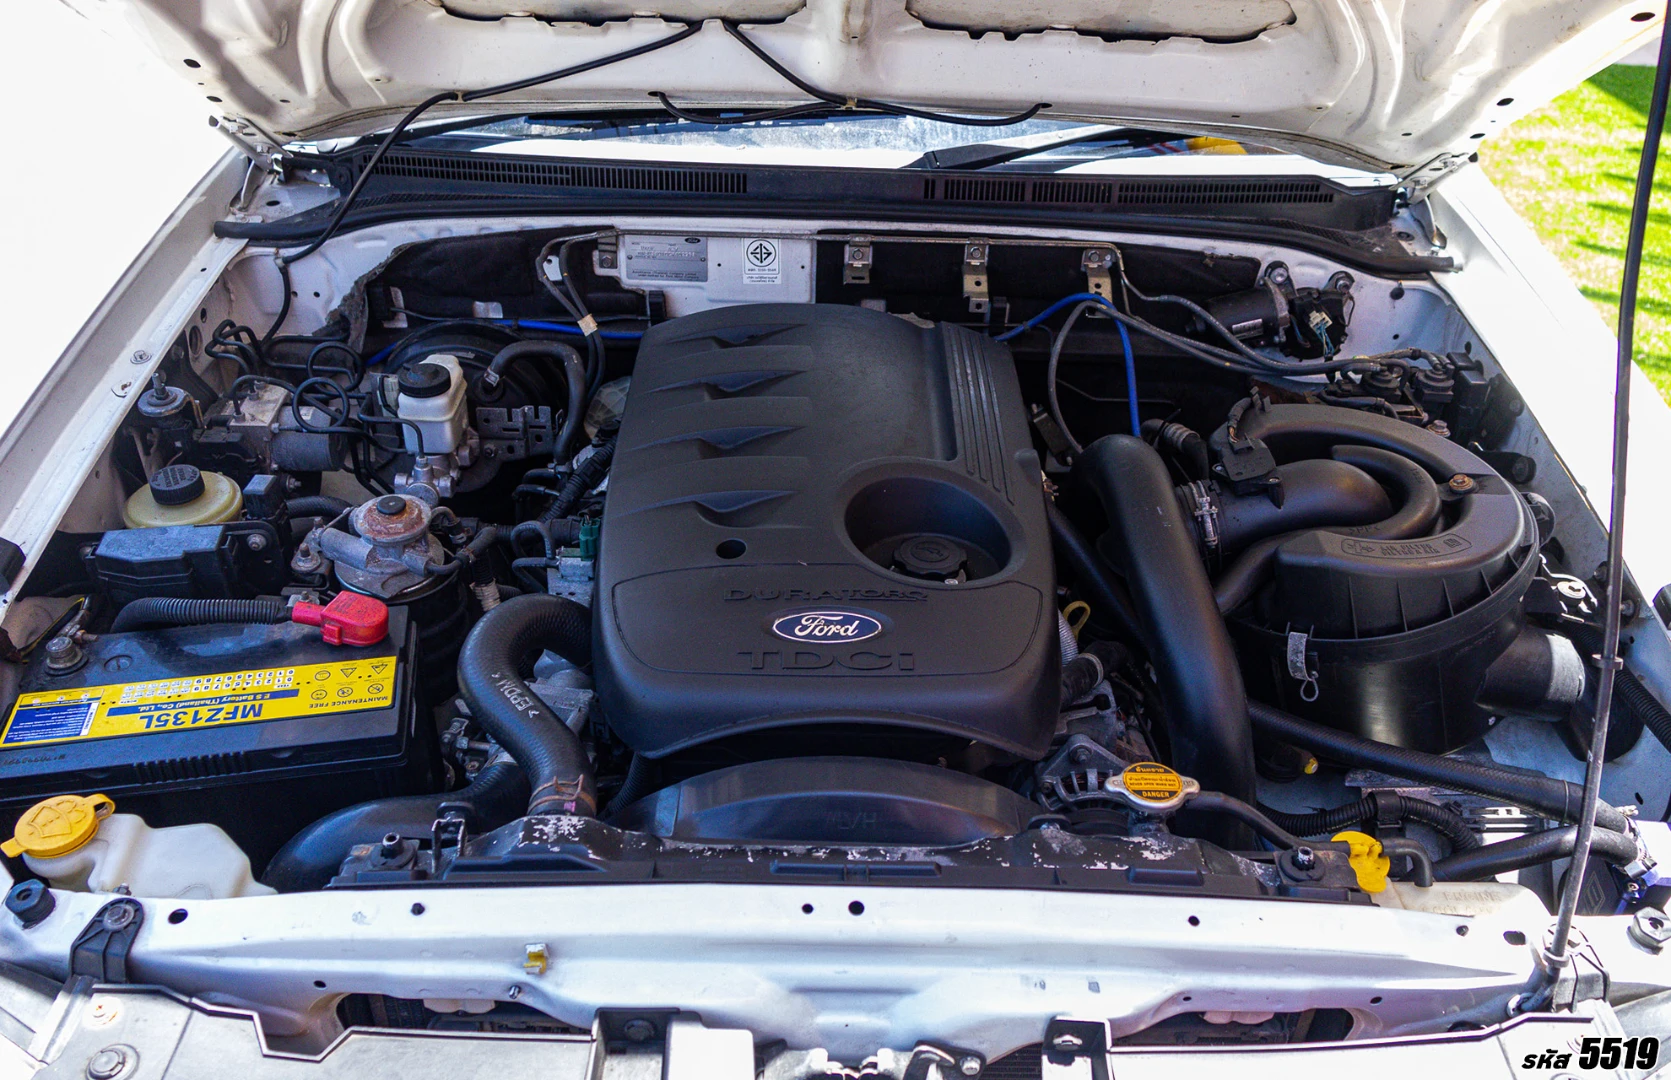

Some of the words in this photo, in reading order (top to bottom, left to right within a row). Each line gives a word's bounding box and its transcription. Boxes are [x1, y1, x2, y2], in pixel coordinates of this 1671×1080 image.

[723, 589, 929, 602] DURATORQ
[794, 613, 859, 637] Ford
[175, 697, 220, 708] (Thailand)
[221, 694, 254, 702] Battery
[332, 696, 388, 707] MAINTENANCE
[139, 703, 264, 729] MFZ135L
[1141, 790, 1170, 798] DANGER
